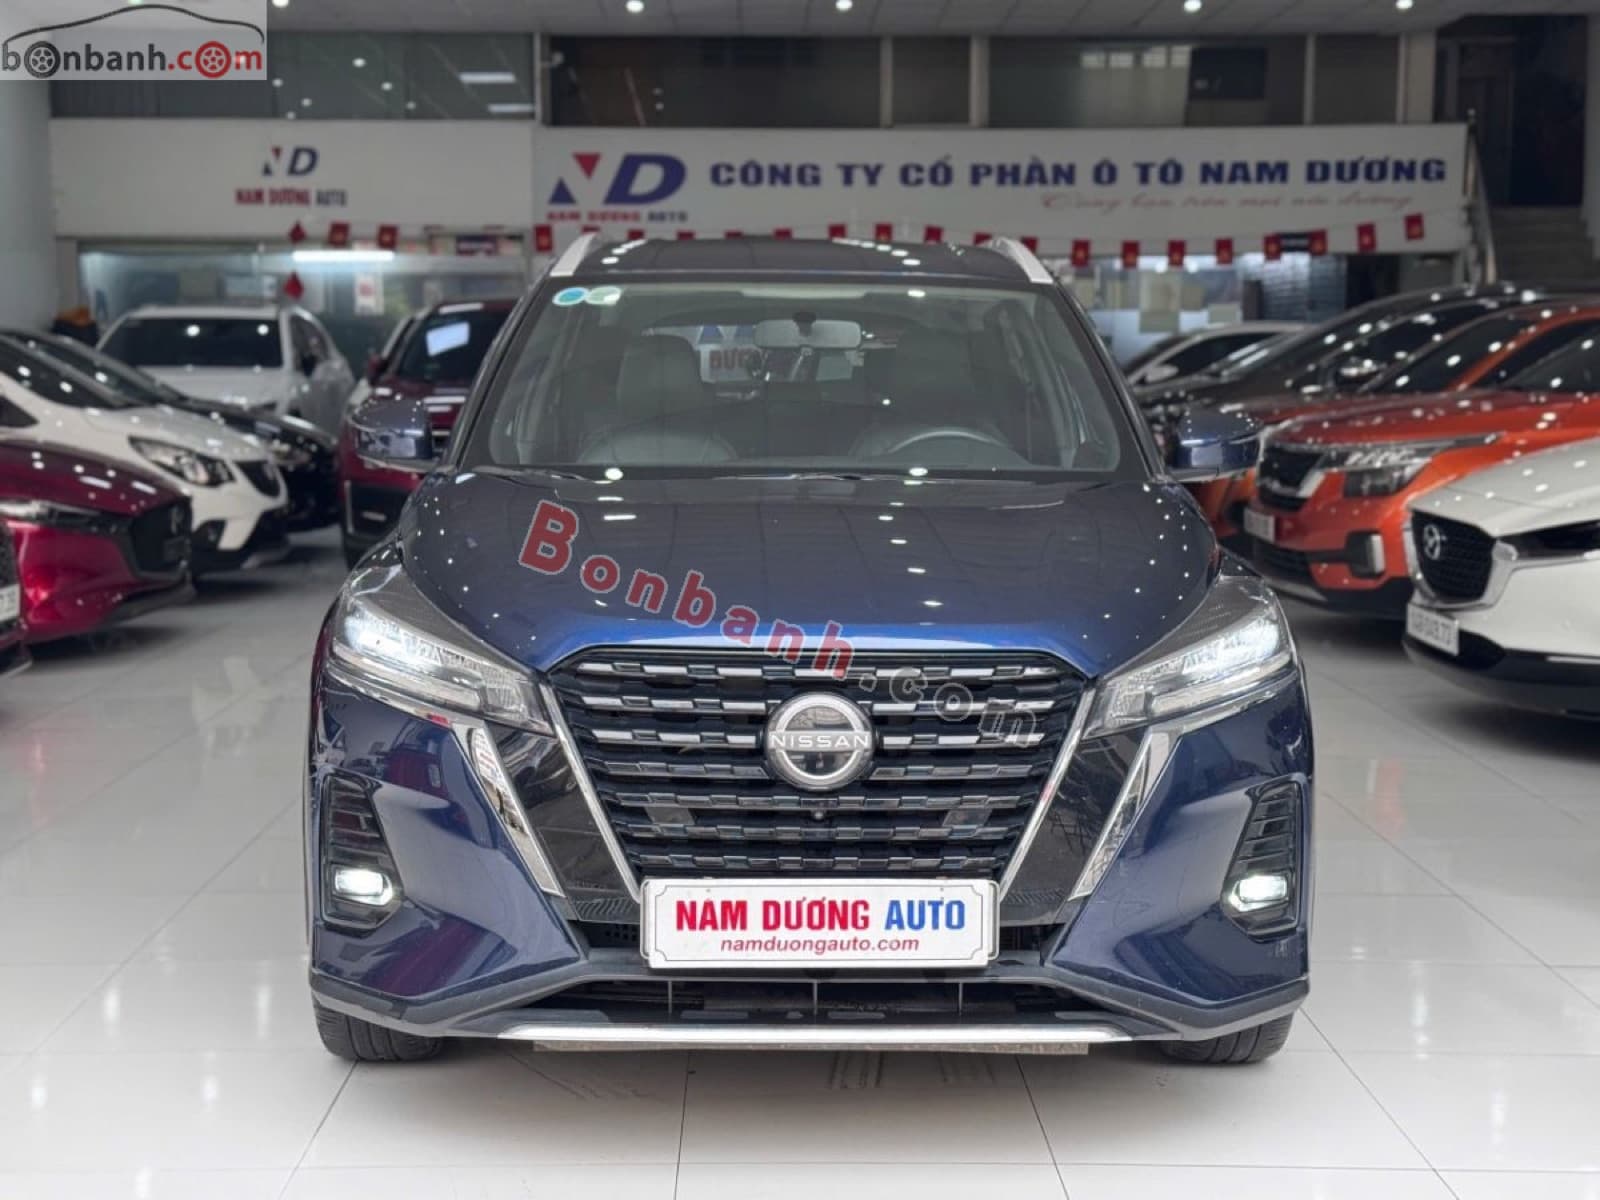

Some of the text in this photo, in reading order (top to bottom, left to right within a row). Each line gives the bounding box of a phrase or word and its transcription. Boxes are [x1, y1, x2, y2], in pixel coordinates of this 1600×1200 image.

[710, 159, 822, 187] CÔNG
[836, 163, 884, 187] TY
[1092, 158, 1118, 186] Ô
[1133, 158, 1184, 186] TÔ
[1199, 160, 1289, 185] NAM
[1305, 154, 1446, 184] DƯƠNG
[770, 734, 869, 749] NISSAN
[675, 896, 966, 932] NAM DƯƠNG AUTO
[720, 936, 919, 956] namduongauto.com
